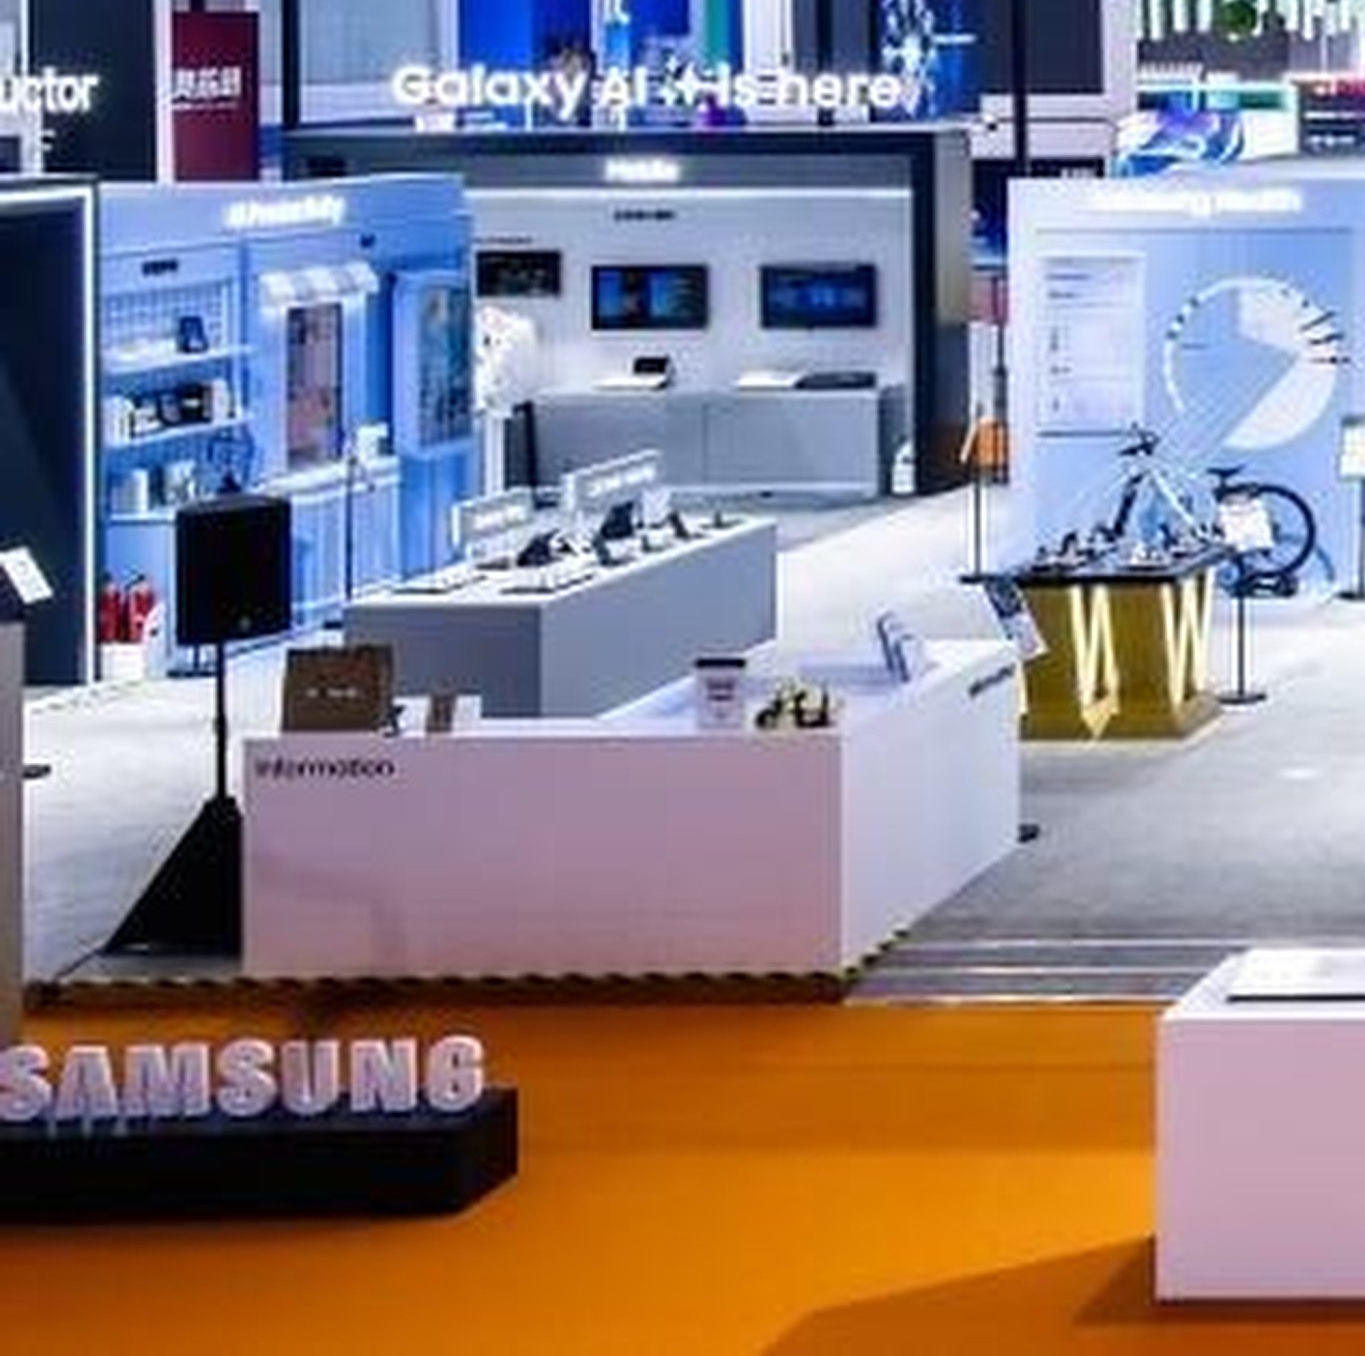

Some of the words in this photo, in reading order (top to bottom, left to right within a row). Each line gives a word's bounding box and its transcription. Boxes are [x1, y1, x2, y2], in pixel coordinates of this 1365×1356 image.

[392, 63, 588, 120] Galaxy
[599, 65, 647, 106] AI
[718, 64, 762, 106] is
[779, 64, 903, 107] here
[0, 1035, 485, 1122] SAMSUNG
